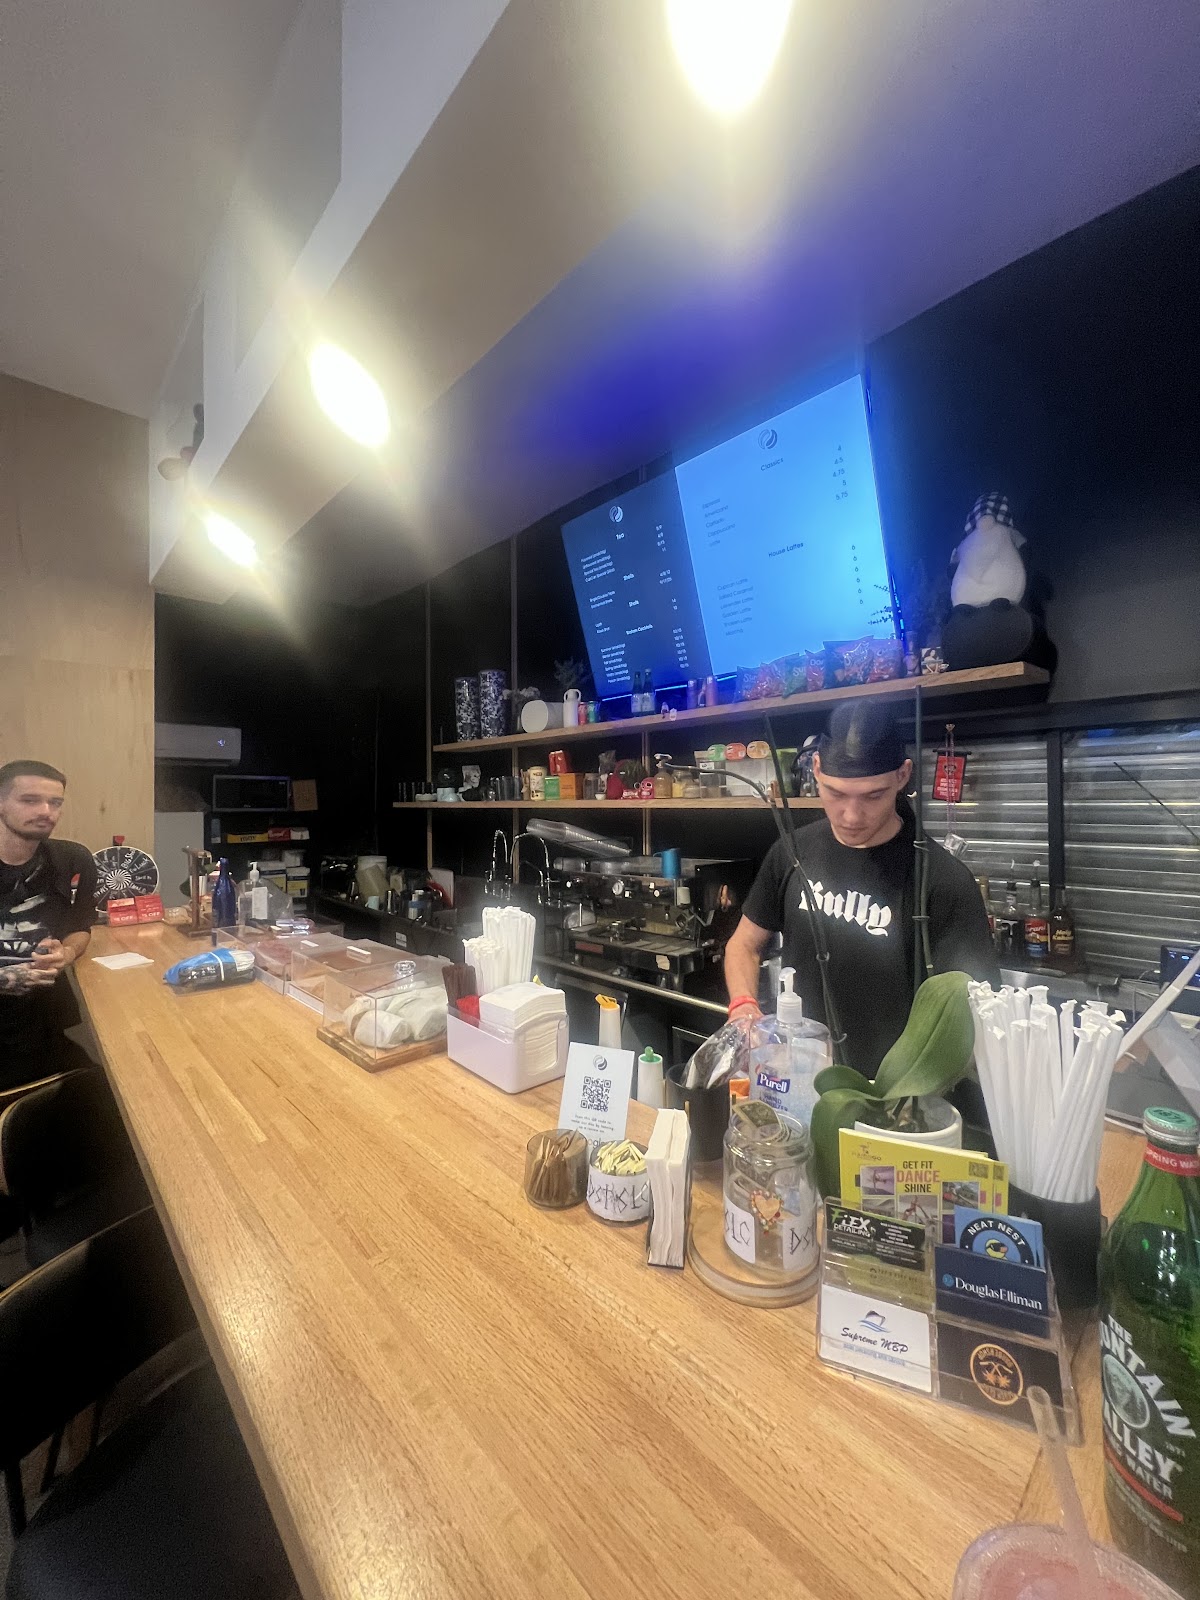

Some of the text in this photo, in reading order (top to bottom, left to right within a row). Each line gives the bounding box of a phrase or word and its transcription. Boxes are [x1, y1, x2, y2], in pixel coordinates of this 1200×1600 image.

[760, 458, 784, 471] Classics
[768, 542, 804, 558] House Lattes
[760, 1073, 788, 1093] Purell
[903, 1161, 934, 1170] GET FIT
[897, 1170, 941, 1184] DANCE
[904, 1184, 932, 1193] SHINE
[834, 1223, 871, 1238] DETAILING
[968, 1220, 1026, 1246] NEAT NEST
[1108, 1314, 1133, 1346] THE
[841, 1327, 909, 1354] Supreme MBP
[1100, 1320, 1196, 1438] UNTAIN
